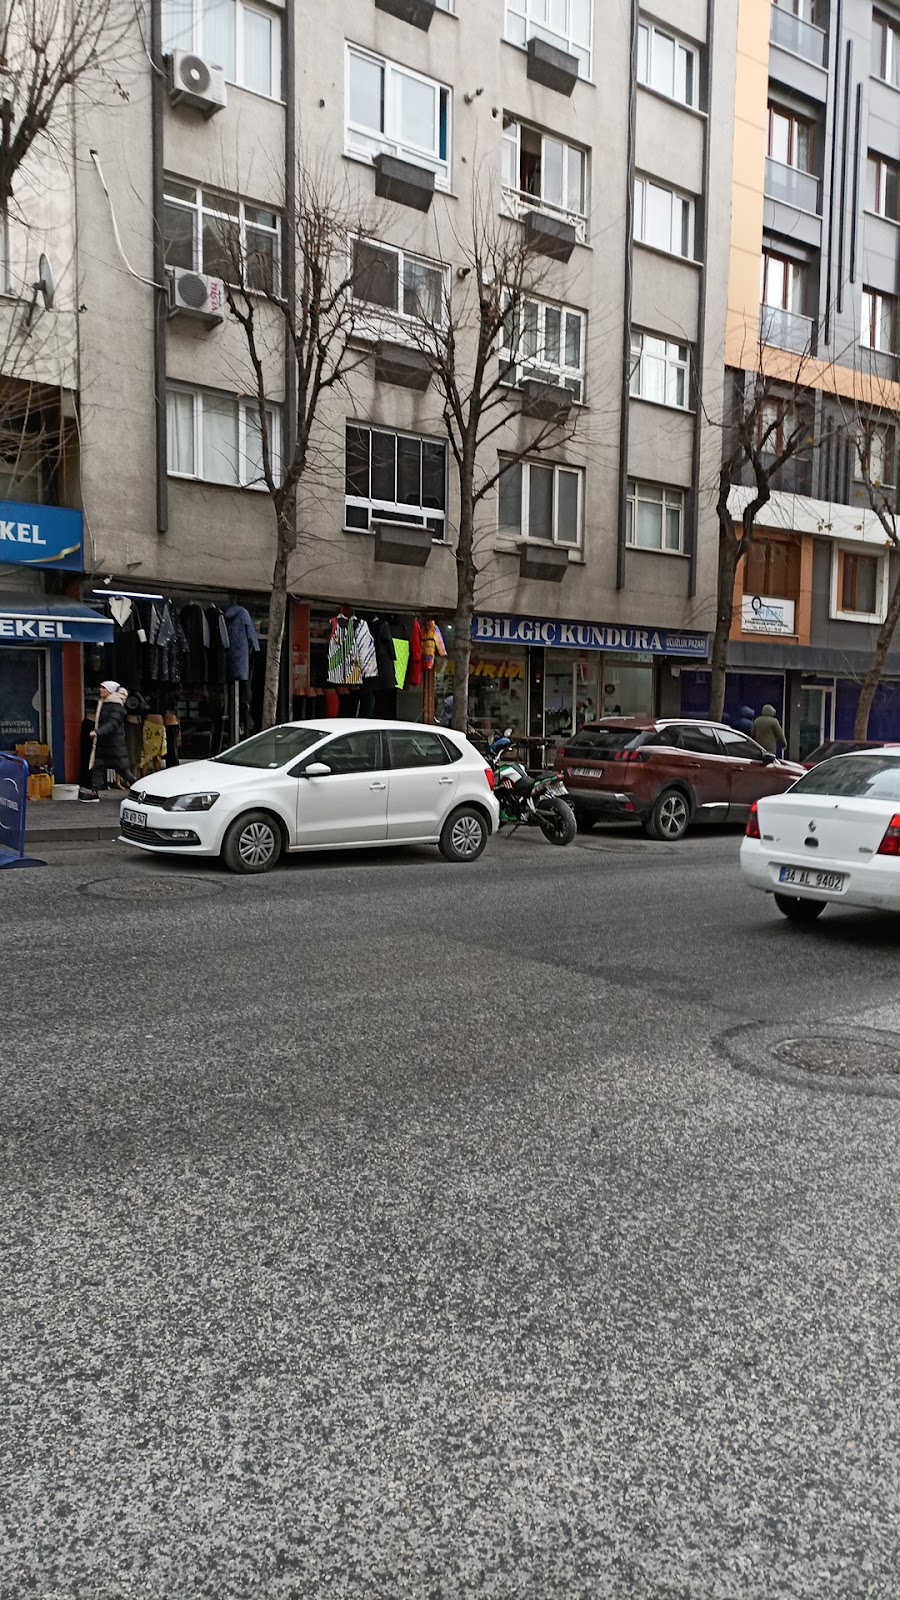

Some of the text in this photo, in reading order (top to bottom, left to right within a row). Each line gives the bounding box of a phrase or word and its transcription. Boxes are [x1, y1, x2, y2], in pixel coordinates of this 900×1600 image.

[0, 520, 47, 545] KEL
[0, 619, 72, 639] EKEL
[560, 624, 663, 650] KUNDURA
[786, 869, 841, 889] 34 AL 9402
